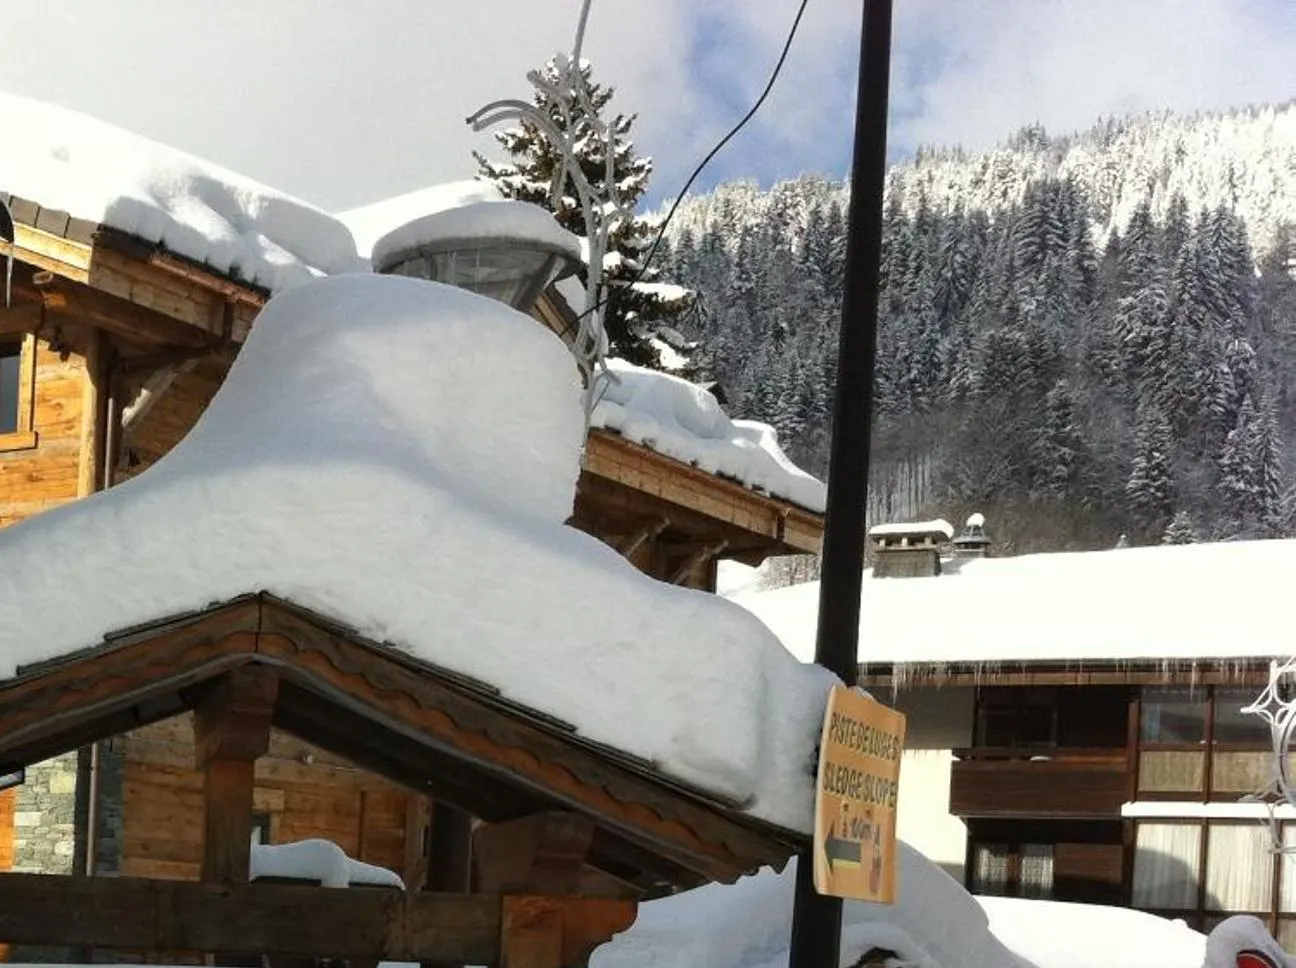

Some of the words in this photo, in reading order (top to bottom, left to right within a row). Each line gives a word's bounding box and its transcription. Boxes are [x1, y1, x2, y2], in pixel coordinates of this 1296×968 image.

[828, 711, 857, 748] PISTE
[856, 721, 870, 753] DE
[823, 760, 863, 799] SLEDGE
[863, 773, 897, 808] SLOPE
